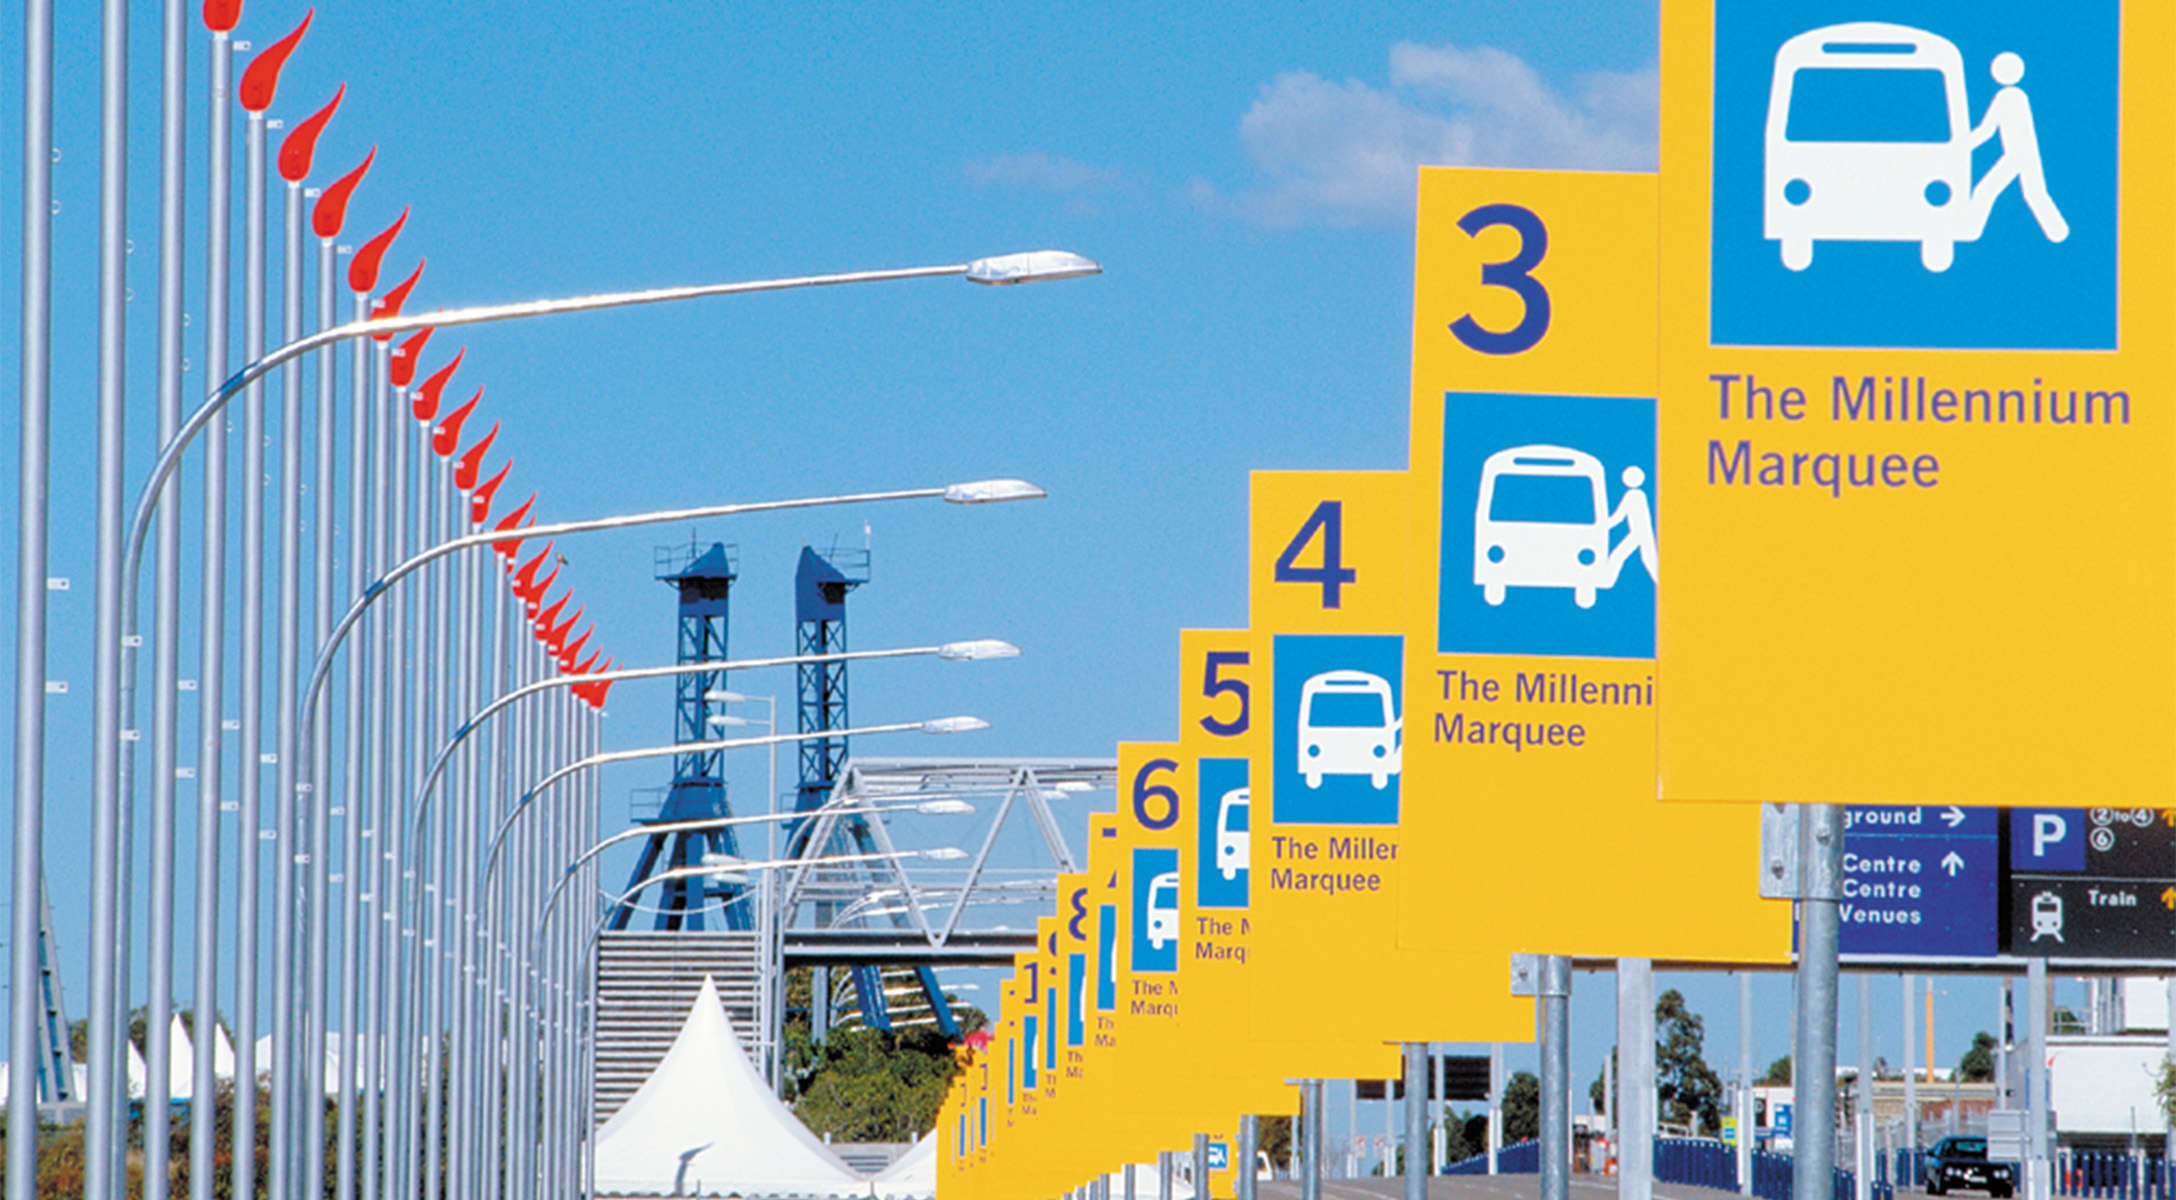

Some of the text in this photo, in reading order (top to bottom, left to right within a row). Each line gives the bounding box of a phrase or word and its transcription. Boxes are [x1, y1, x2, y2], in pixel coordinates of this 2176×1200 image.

[1448, 203, 1551, 355] 3
[1708, 374, 2130, 425] The Millennium
[1707, 440, 1941, 499] Marquee
[1274, 500, 1357, 609] 4
[1199, 651, 1250, 737] 5
[1436, 670, 1500, 702] The
[1434, 712, 1586, 753] Marquee
[1132, 759, 1179, 831] 6
[1271, 836, 1319, 860] The
[2033, 813, 2067, 857] P
[1842, 853, 1923, 874] Centre
[1271, 867, 1382, 896] Marquee
[1842, 879, 1923, 900] Centre
[1838, 903, 1923, 925] Venues
[2088, 889, 2138, 907] Train
[1196, 917, 1233, 936] The
[1132, 979, 1163, 996] The
